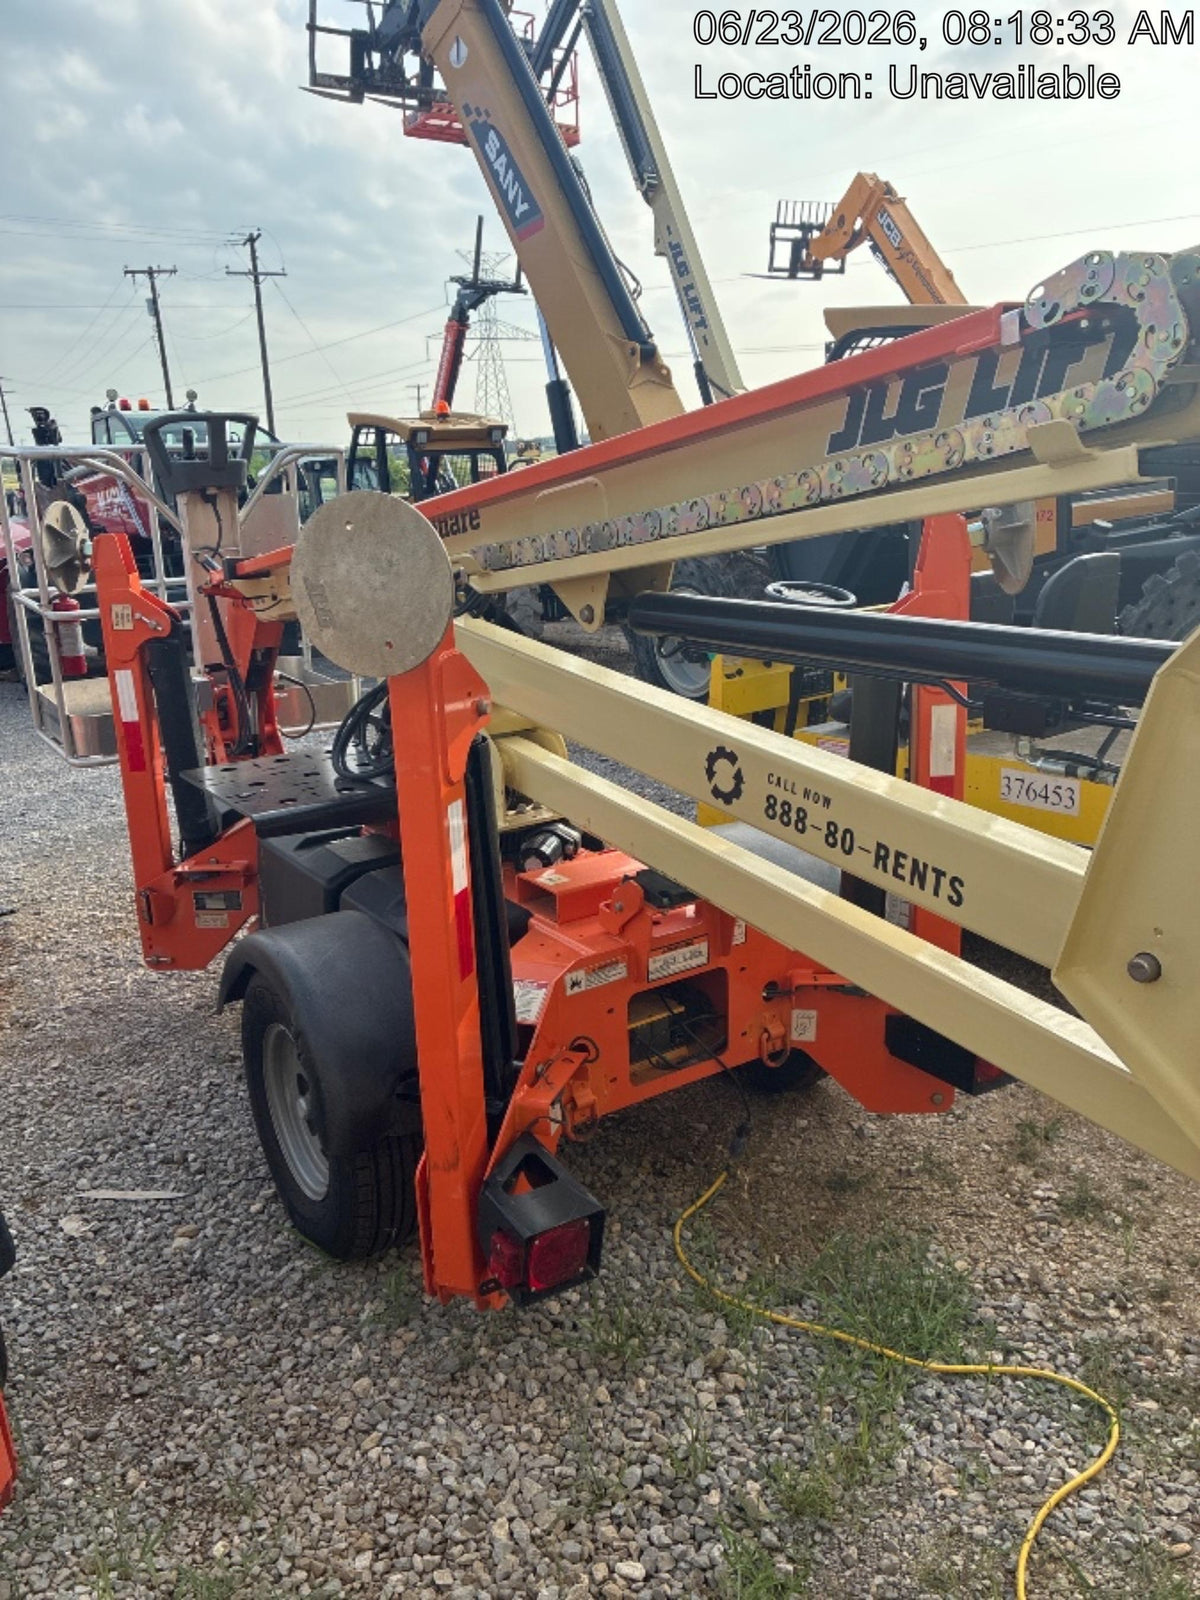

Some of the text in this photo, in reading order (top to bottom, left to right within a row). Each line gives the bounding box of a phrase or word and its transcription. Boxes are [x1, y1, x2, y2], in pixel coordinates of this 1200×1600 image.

[485, 129, 530, 218] SANY
[876, 212, 902, 248] JCB
[668, 241, 708, 329] JLG LIFT
[826, 358, 952, 455] JLG
[767, 773, 833, 810] CALL NOW
[1000, 775, 1076, 810] 376453
[764, 794, 965, 908] 888-80-RENTS
